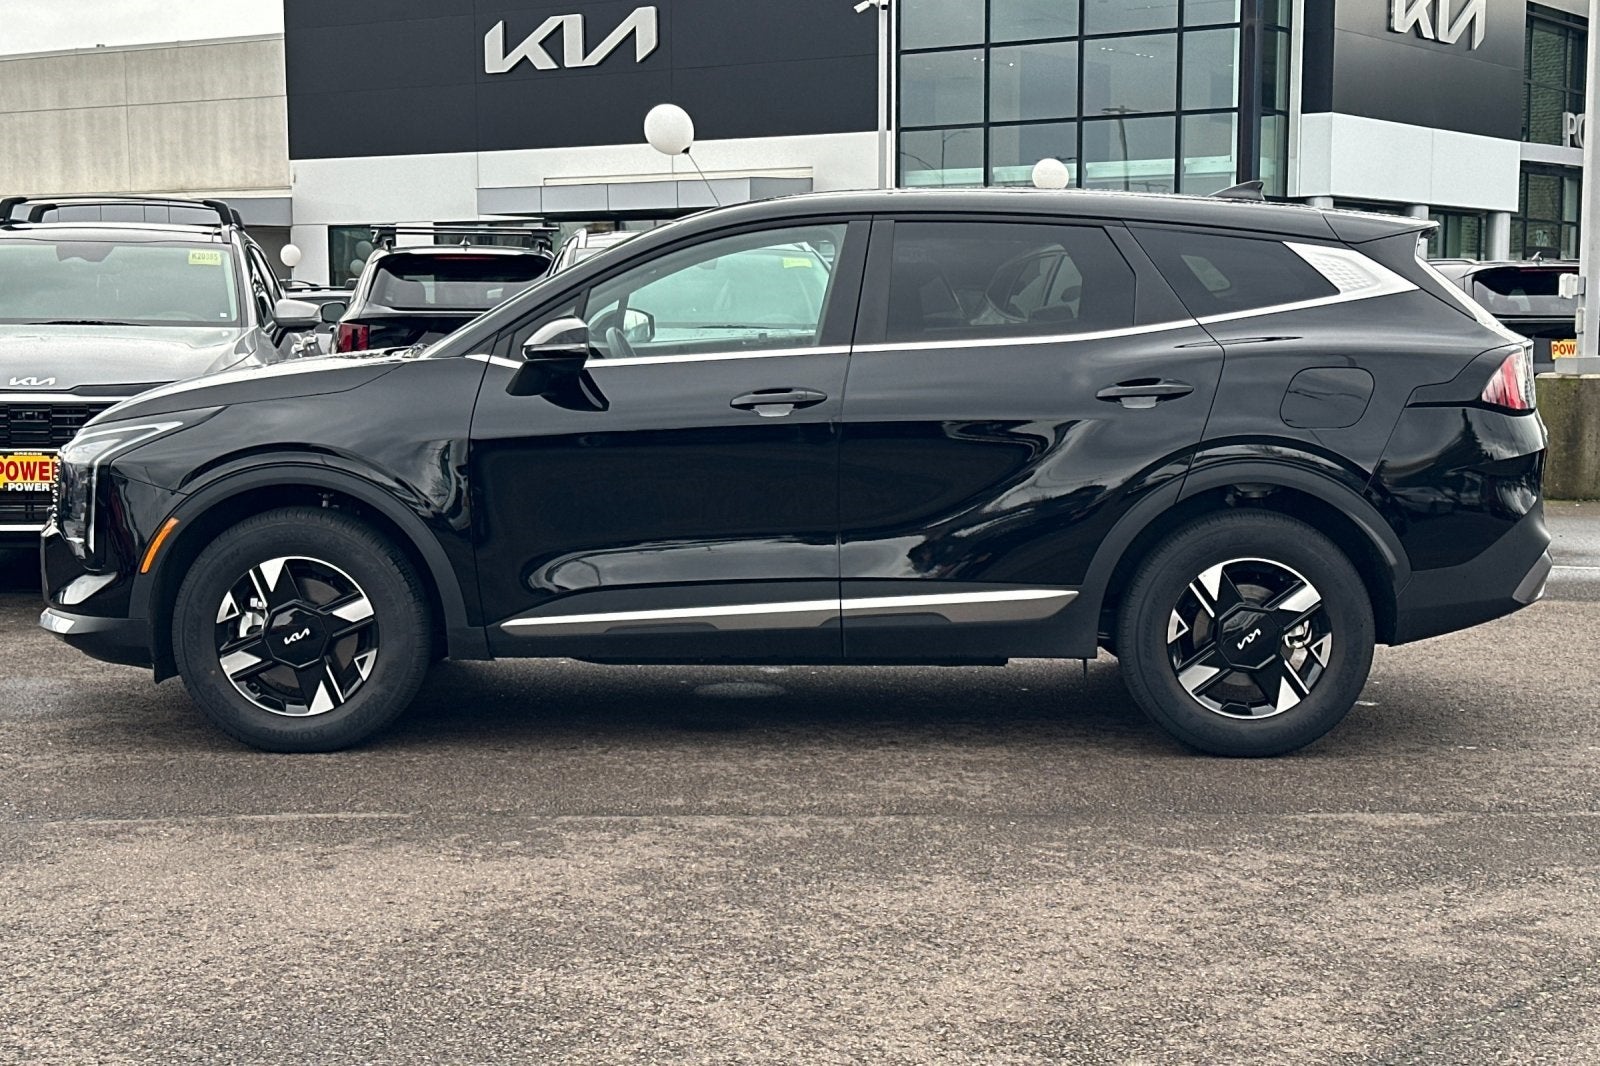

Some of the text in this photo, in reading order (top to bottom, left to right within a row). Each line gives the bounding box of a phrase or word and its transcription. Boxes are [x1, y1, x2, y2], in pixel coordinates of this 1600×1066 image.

[484, 5, 658, 75] KIA
[9, 376, 56, 386] KIA
[7, 482, 50, 491] POWER
[283, 627, 311, 645] KIA
